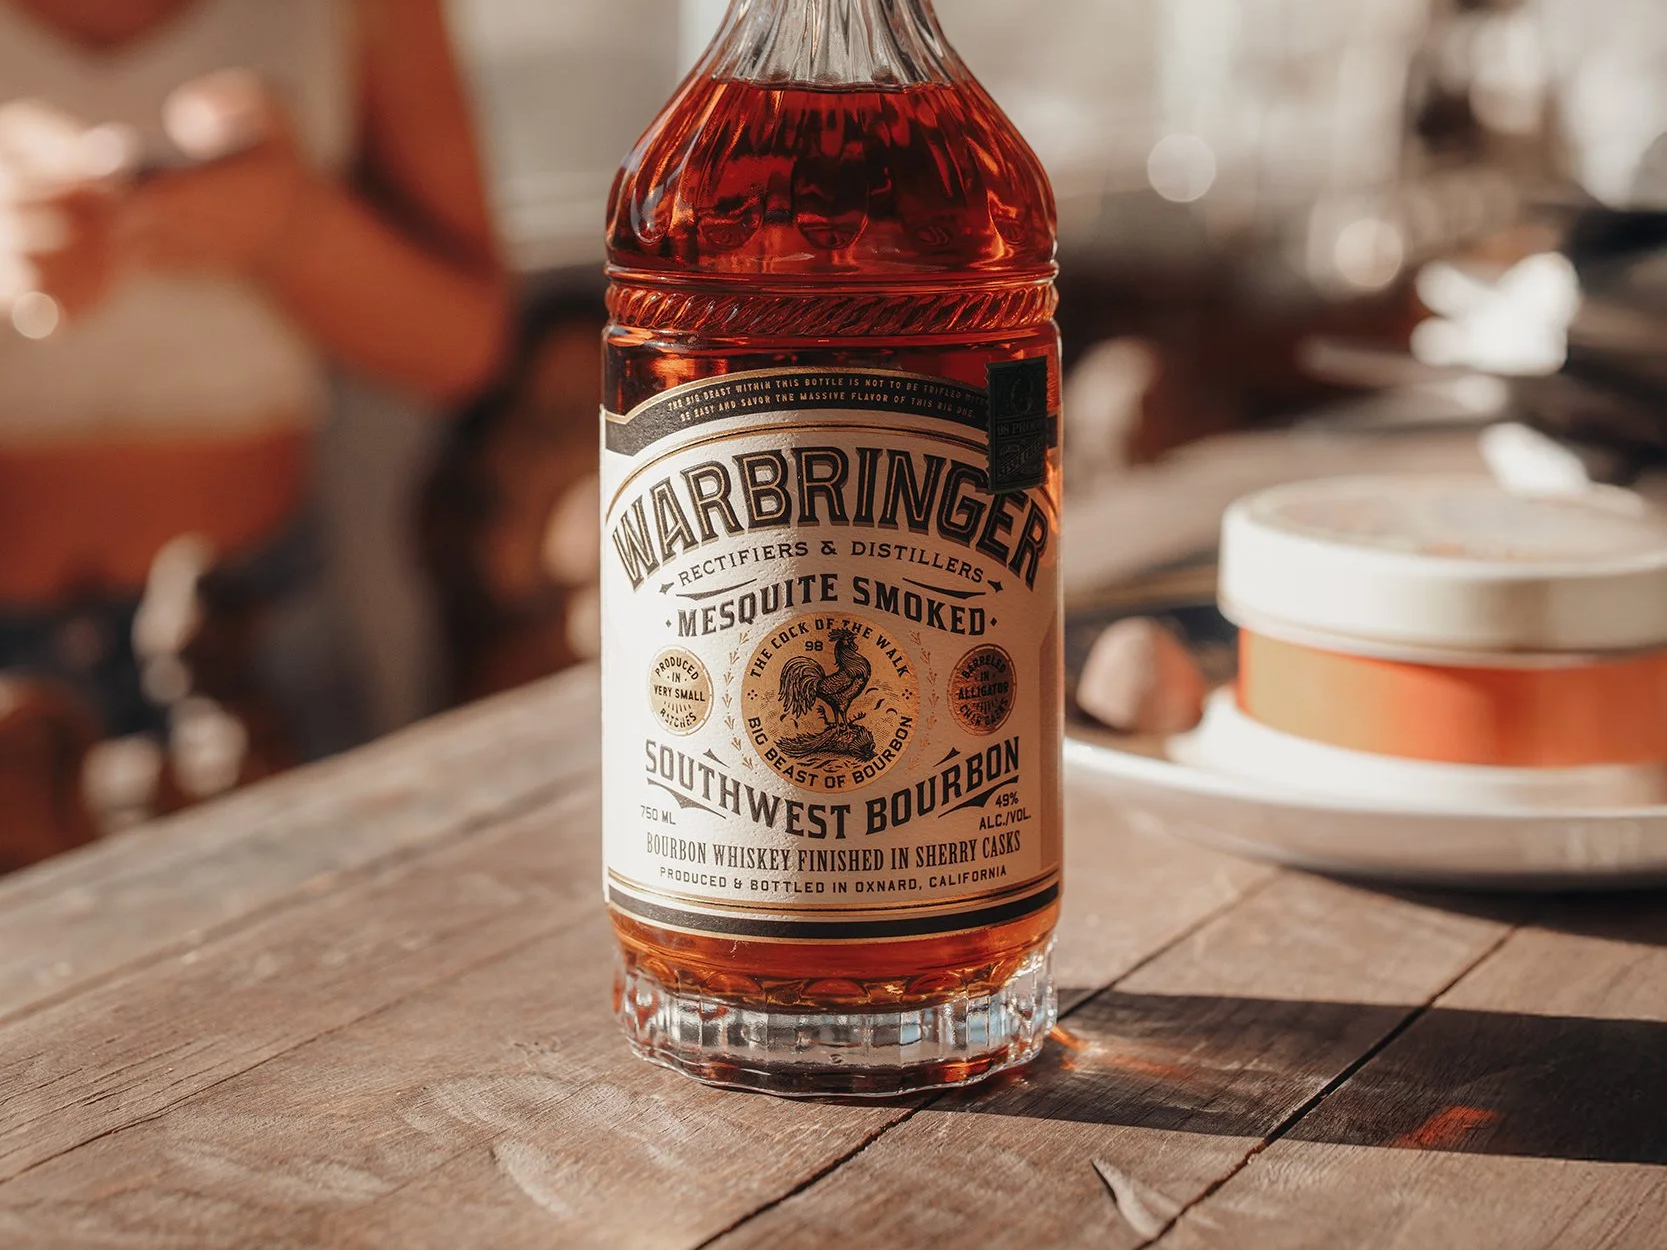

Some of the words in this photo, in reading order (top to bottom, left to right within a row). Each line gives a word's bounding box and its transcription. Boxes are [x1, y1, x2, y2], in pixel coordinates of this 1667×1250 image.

[667, 399, 683, 412] THE
[686, 394, 700, 408] BIG
[703, 387, 731, 401] BEAST
[735, 381, 771, 394] WITHIN
[775, 378, 799, 389] THIS
[804, 377, 844, 388] BOTTLE
[849, 377, 860, 386] IS
[865, 378, 884, 388] NOT
[889, 380, 901, 389] TO
[906, 382, 918, 392] BE
[680, 412, 691, 422] BE
[694, 406, 716, 419] EASY
[718, 401, 736, 413] AND
[740, 395, 771, 408] SAVOR
[775, 393, 795, 402] THE
[800, 391, 845, 401] MASSIVE
[851, 392, 889, 403] FLAVOR
[893, 395, 905, 405] OF
[911, 397, 933, 409] THIS
[997, 424, 1010, 436] 98
[1012, 419, 1045, 434] PROO
[612, 447, 1050, 593] WARBRINGER
[680, 541, 809, 588] RECTIFIERS
[820, 540, 838, 556] &
[850, 541, 984, 584] DISTILLERS
[677, 573, 838, 638] MESQUITE
[853, 577, 987, 636] SMOKED
[750, 648, 772, 678] THE
[771, 621, 809, 649] COCK
[815, 618, 835, 630] OF
[842, 619, 873, 639] THE
[875, 634, 911, 678] WALK
[804, 640, 824, 652] 98
[655, 656, 699, 681] PRODUCED
[671, 671, 681, 683] IN
[980, 670, 990, 682] IN
[654, 684, 672, 697] VERY
[675, 688, 706, 702] SMALL
[958, 681, 1009, 700] ALLIGATOR
[747, 716, 769, 746] BIG
[764, 748, 819, 787] BEAST
[824, 774, 846, 789] OF
[851, 715, 913, 785] BOURBON
[645, 738, 851, 839] SOUTHWEST
[865, 735, 1020, 836] BOURBON
[995, 791, 1019, 808] 49%
[640, 805, 658, 821] 750
[662, 810, 677, 826] ML
[979, 807, 1032, 831] ALC./VOL.
[647, 831, 707, 865] BOURBON
[712, 843, 791, 872] WHISKEY
[797, 848, 884, 873] FINISHED
[890, 847, 909, 870] IN
[916, 838, 978, 868] SHERRY
[982, 830, 1021, 859] CASKS
[660, 866, 727, 888] PRODUCED
[734, 877, 743, 890] &
[750, 879, 825, 894] BOTTLED
[833, 882, 847, 893] IN
[855, 878, 922, 894] OXNARD,
[929, 865, 1008, 888] CALIFORNIA
